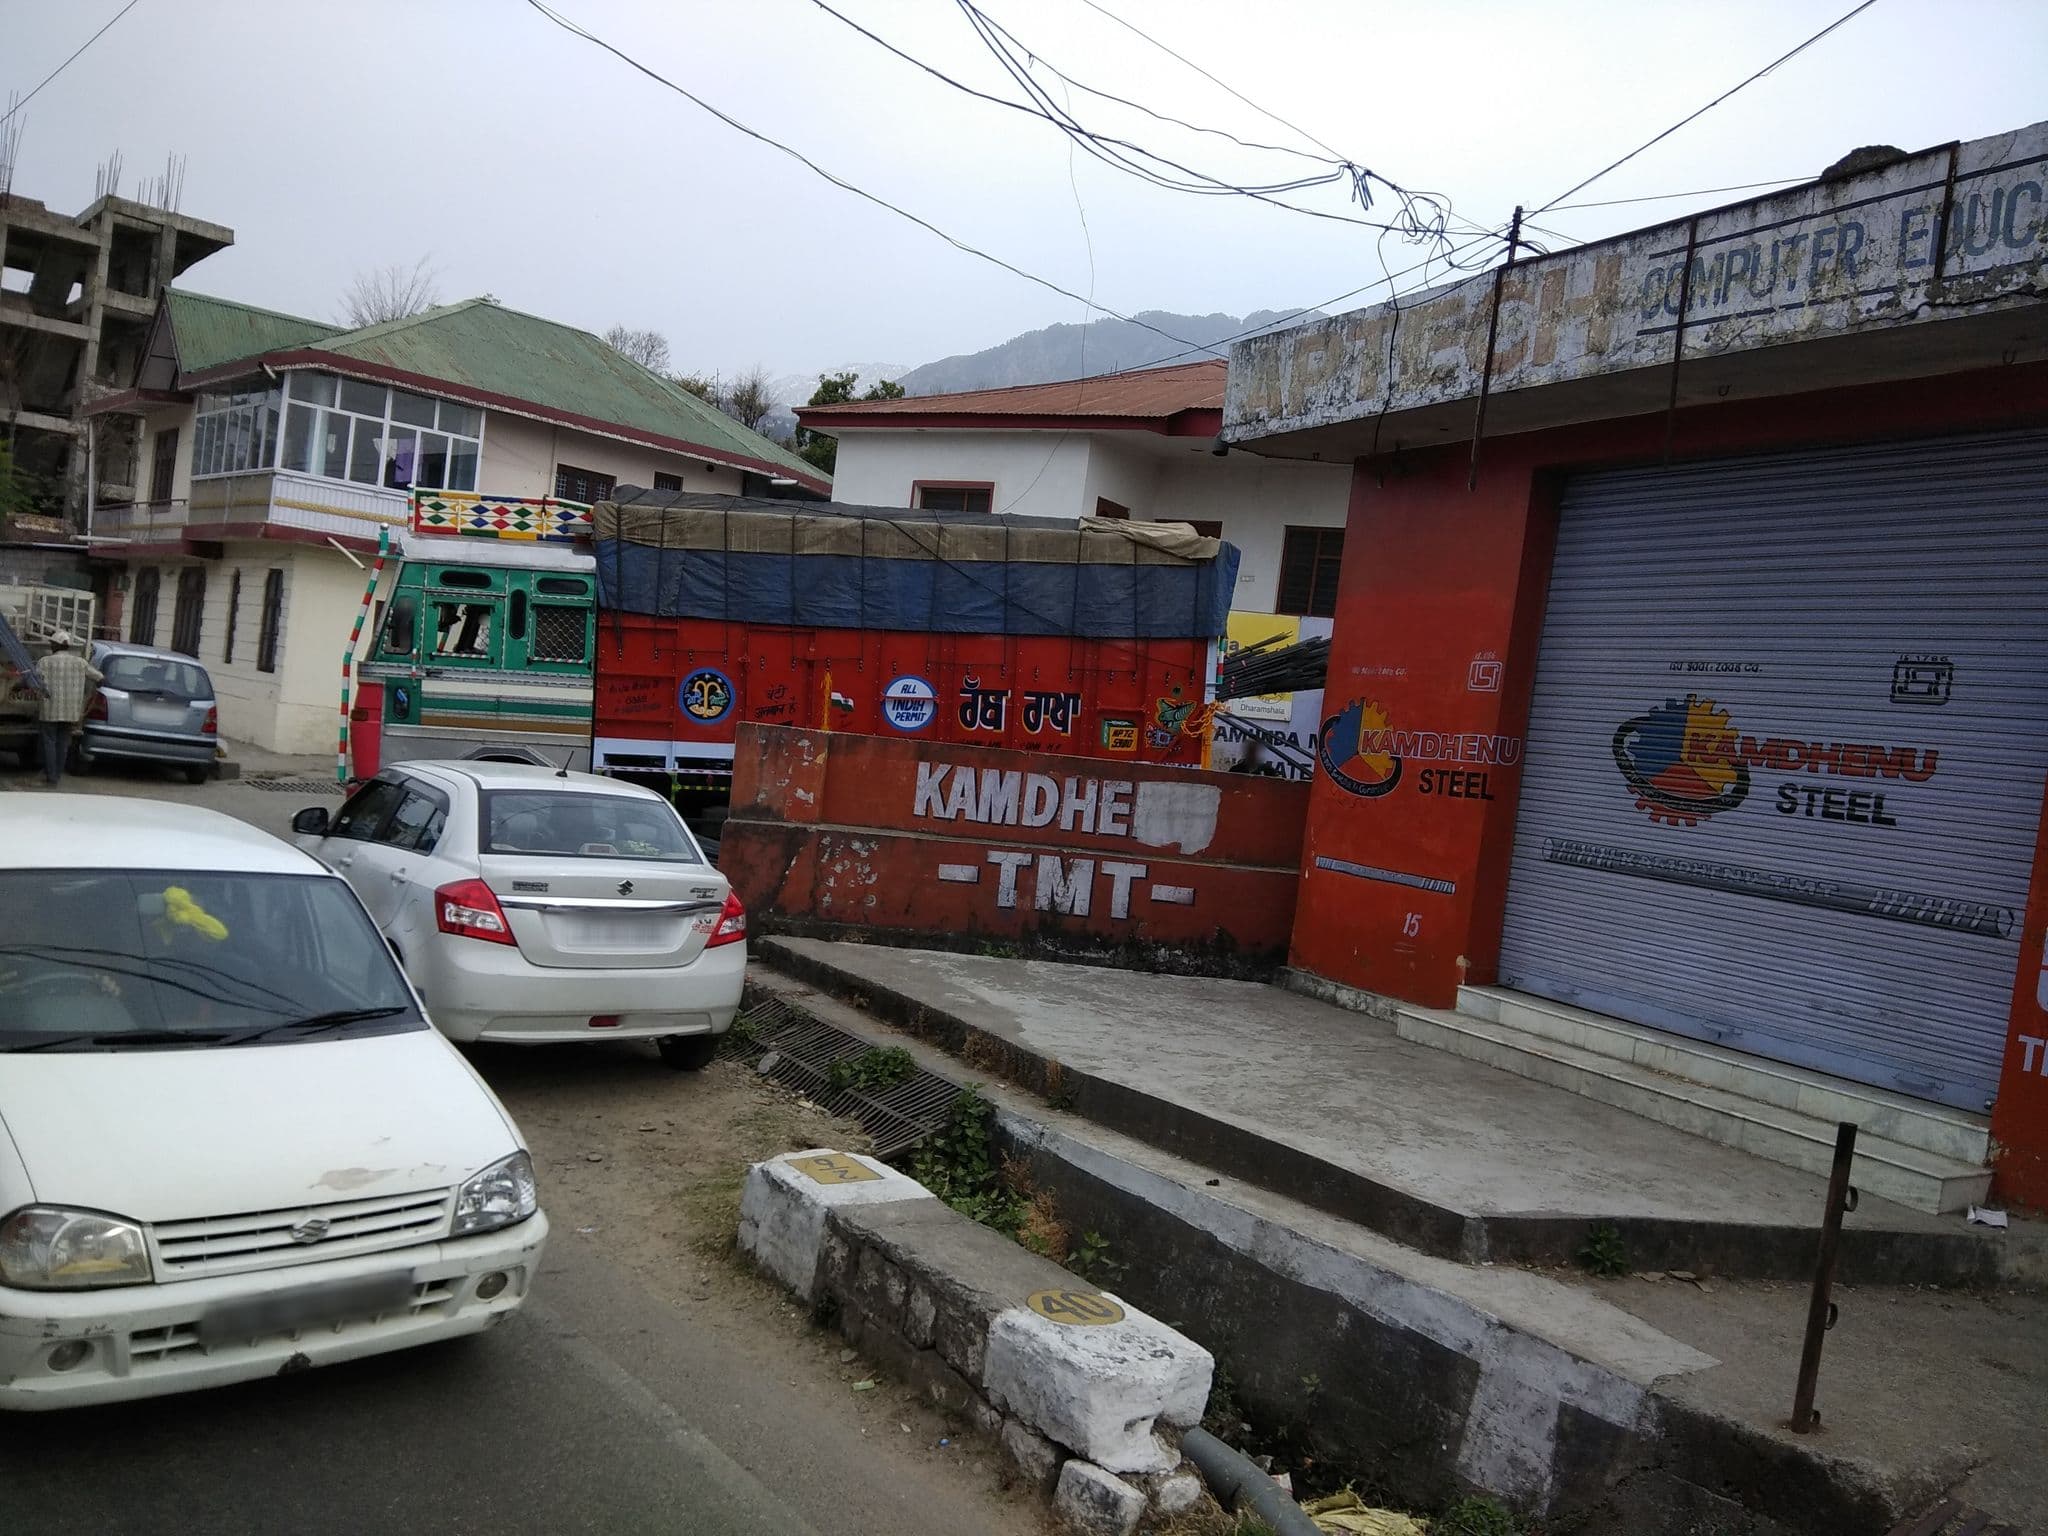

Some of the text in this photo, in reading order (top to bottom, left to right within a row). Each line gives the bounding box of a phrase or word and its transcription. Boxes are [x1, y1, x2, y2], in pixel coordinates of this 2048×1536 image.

[1638, 221, 1865, 320] COMPUTER
[900, 683, 917, 695] ALL
[894, 711, 927, 723] PERMIT
[1240, 702, 1285, 715] Dharamshala
[1360, 729, 1521, 766] KAMDHENU
[1686, 731, 1939, 782] KAMDHENU
[1418, 768, 1496, 800] STEEL
[1776, 783, 1897, 826] STEEL
[1403, 912, 1422, 937] 15
[1043, 1294, 1113, 1321] 40
